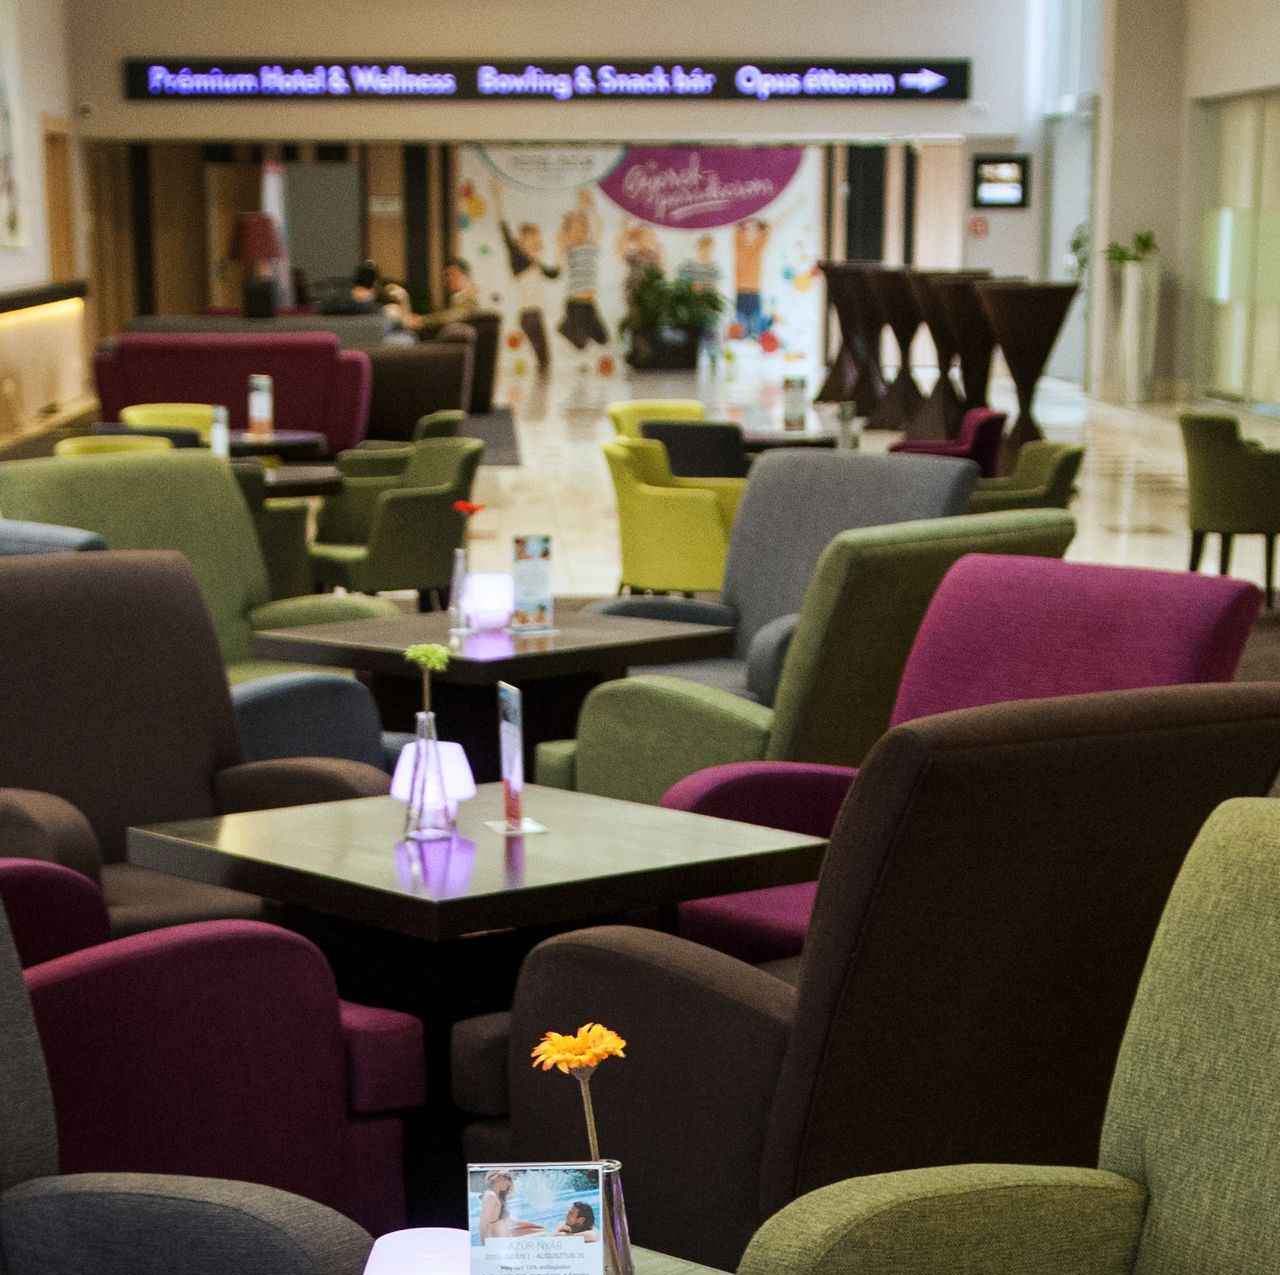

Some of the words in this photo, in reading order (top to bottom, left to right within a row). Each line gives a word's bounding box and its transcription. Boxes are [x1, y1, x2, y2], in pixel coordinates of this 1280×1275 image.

[260, 65, 327, 94] Hotel
[327, 65, 351, 94] &
[350, 65, 457, 94] Wellness
[477, 65, 573, 99] Bowling
[573, 65, 597, 94] &
[597, 65, 671, 94] Snack
[735, 65, 802, 100] Opus
